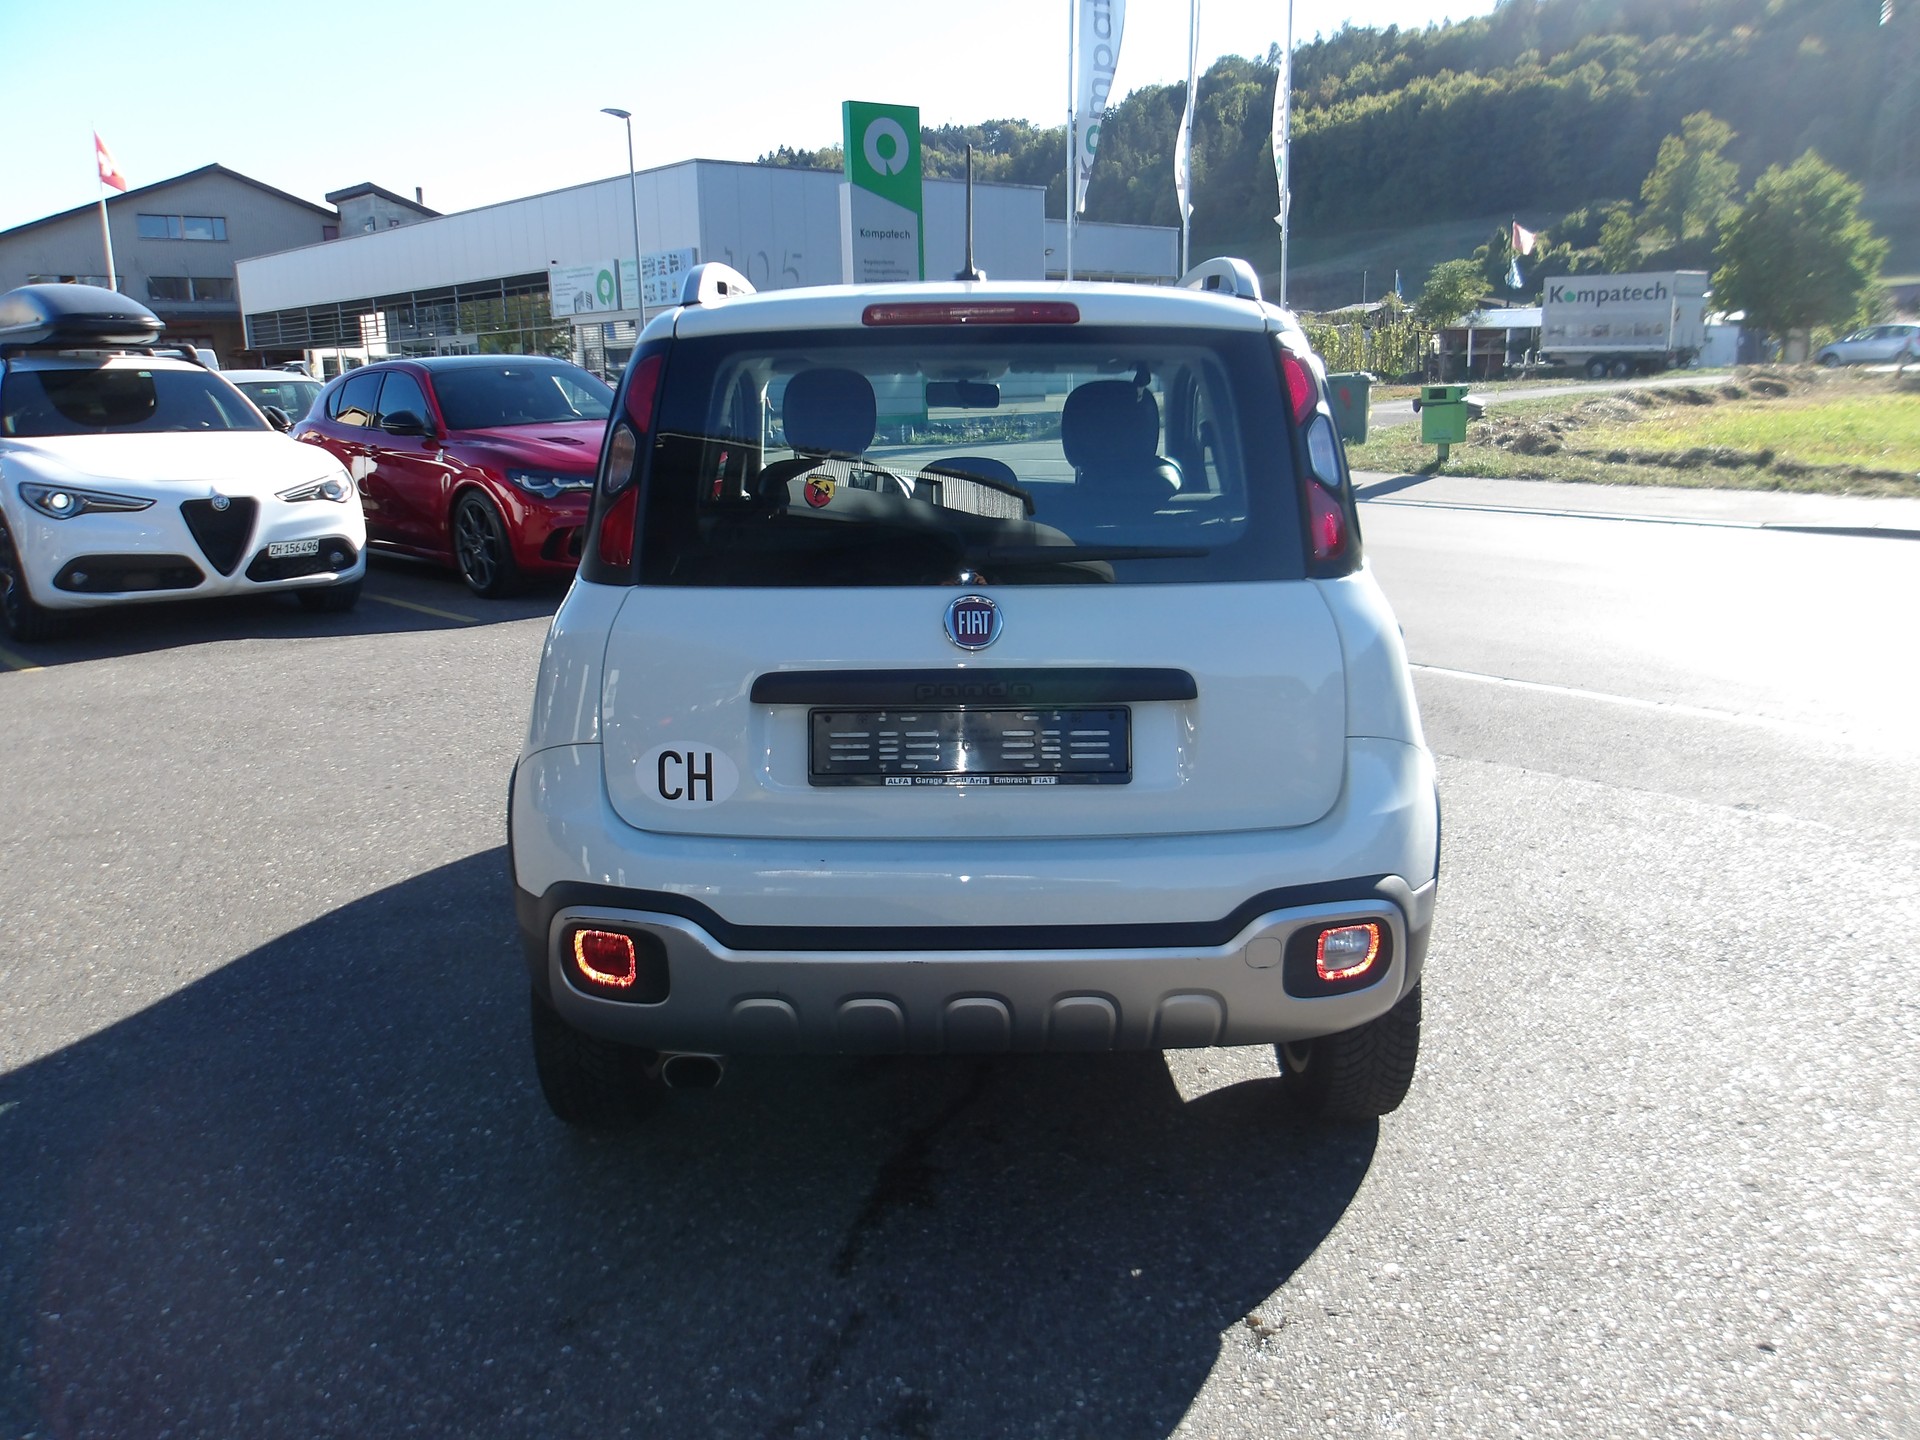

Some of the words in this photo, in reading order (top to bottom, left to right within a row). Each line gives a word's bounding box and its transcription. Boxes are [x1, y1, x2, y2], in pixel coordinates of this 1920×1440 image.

[860, 228, 911, 240] Kompatech
[958, 610, 991, 635] FIAT
[915, 681, 1034, 701] panda
[658, 750, 713, 801] CH
[915, 777, 943, 785] Garage
[993, 776, 1028, 784] Embrach
